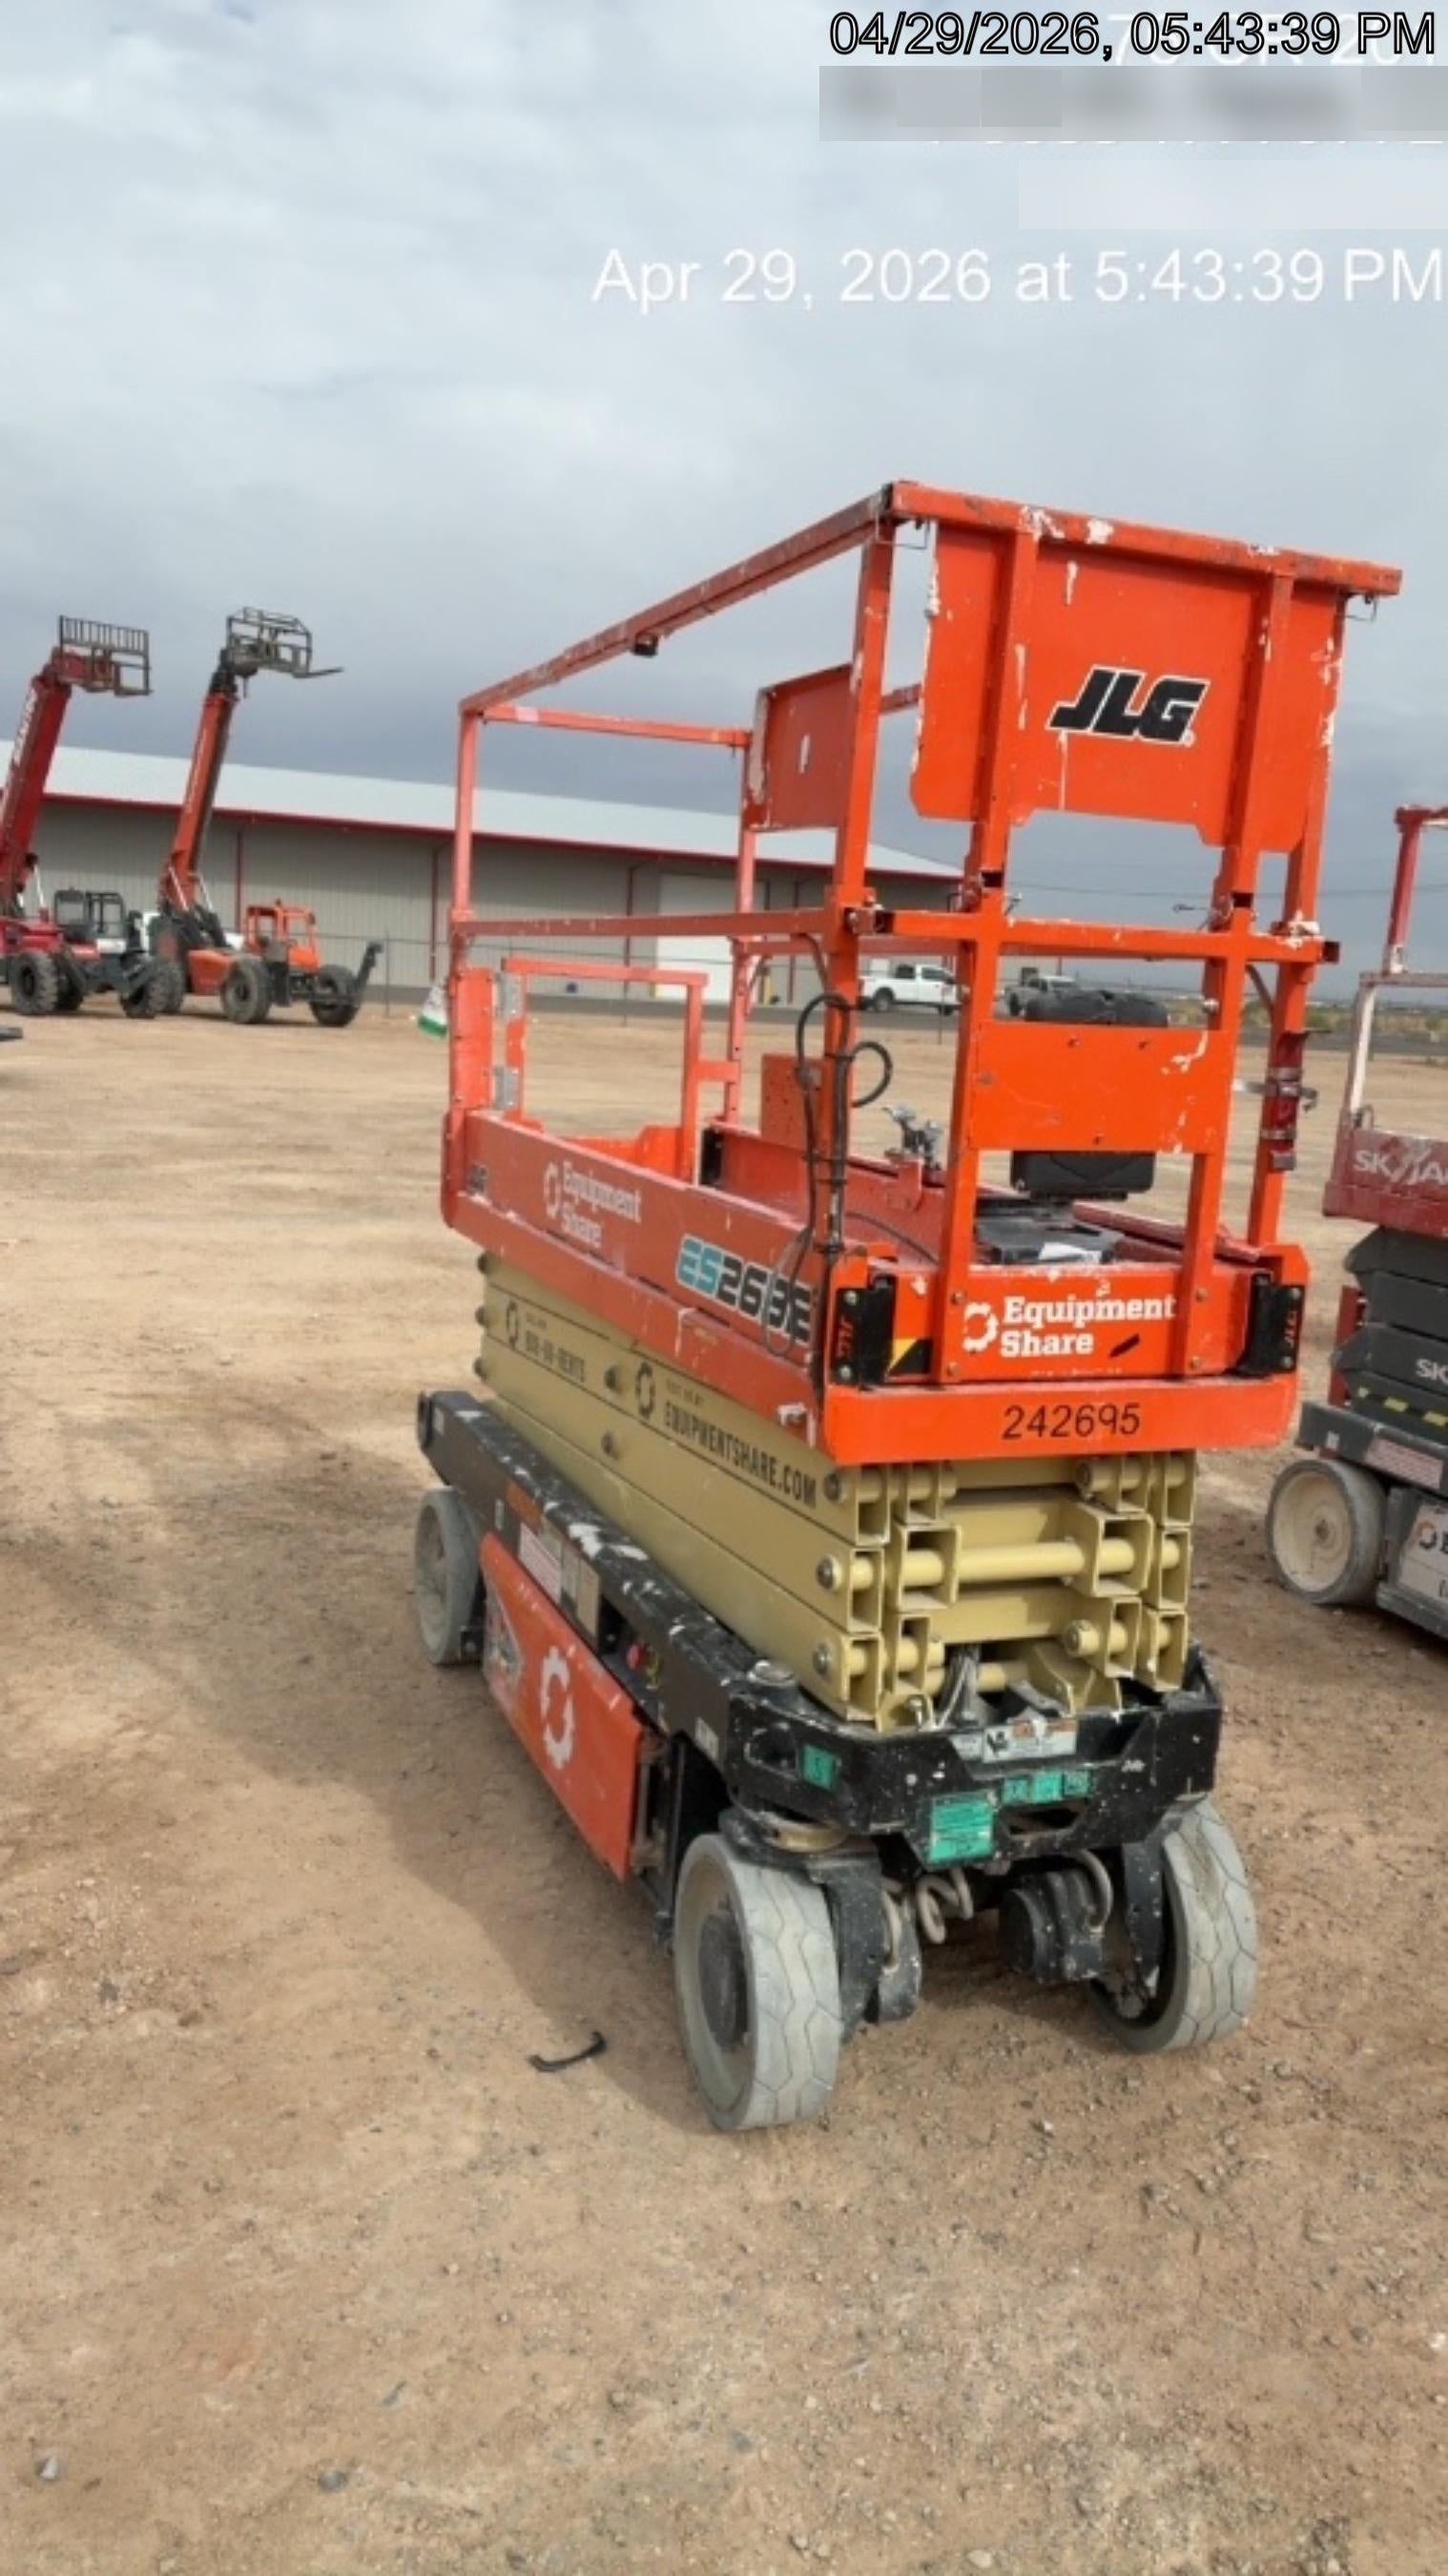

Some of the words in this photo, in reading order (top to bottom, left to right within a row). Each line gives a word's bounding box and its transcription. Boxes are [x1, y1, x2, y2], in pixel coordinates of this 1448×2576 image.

[1046, 665, 1210, 745] JLG
[563, 1160, 642, 1225] Equipment
[1003, 1295, 1176, 1329] Equipment
[1001, 1329, 1094, 1359] Share
[1002, 1402, 1141, 1441] 242695
